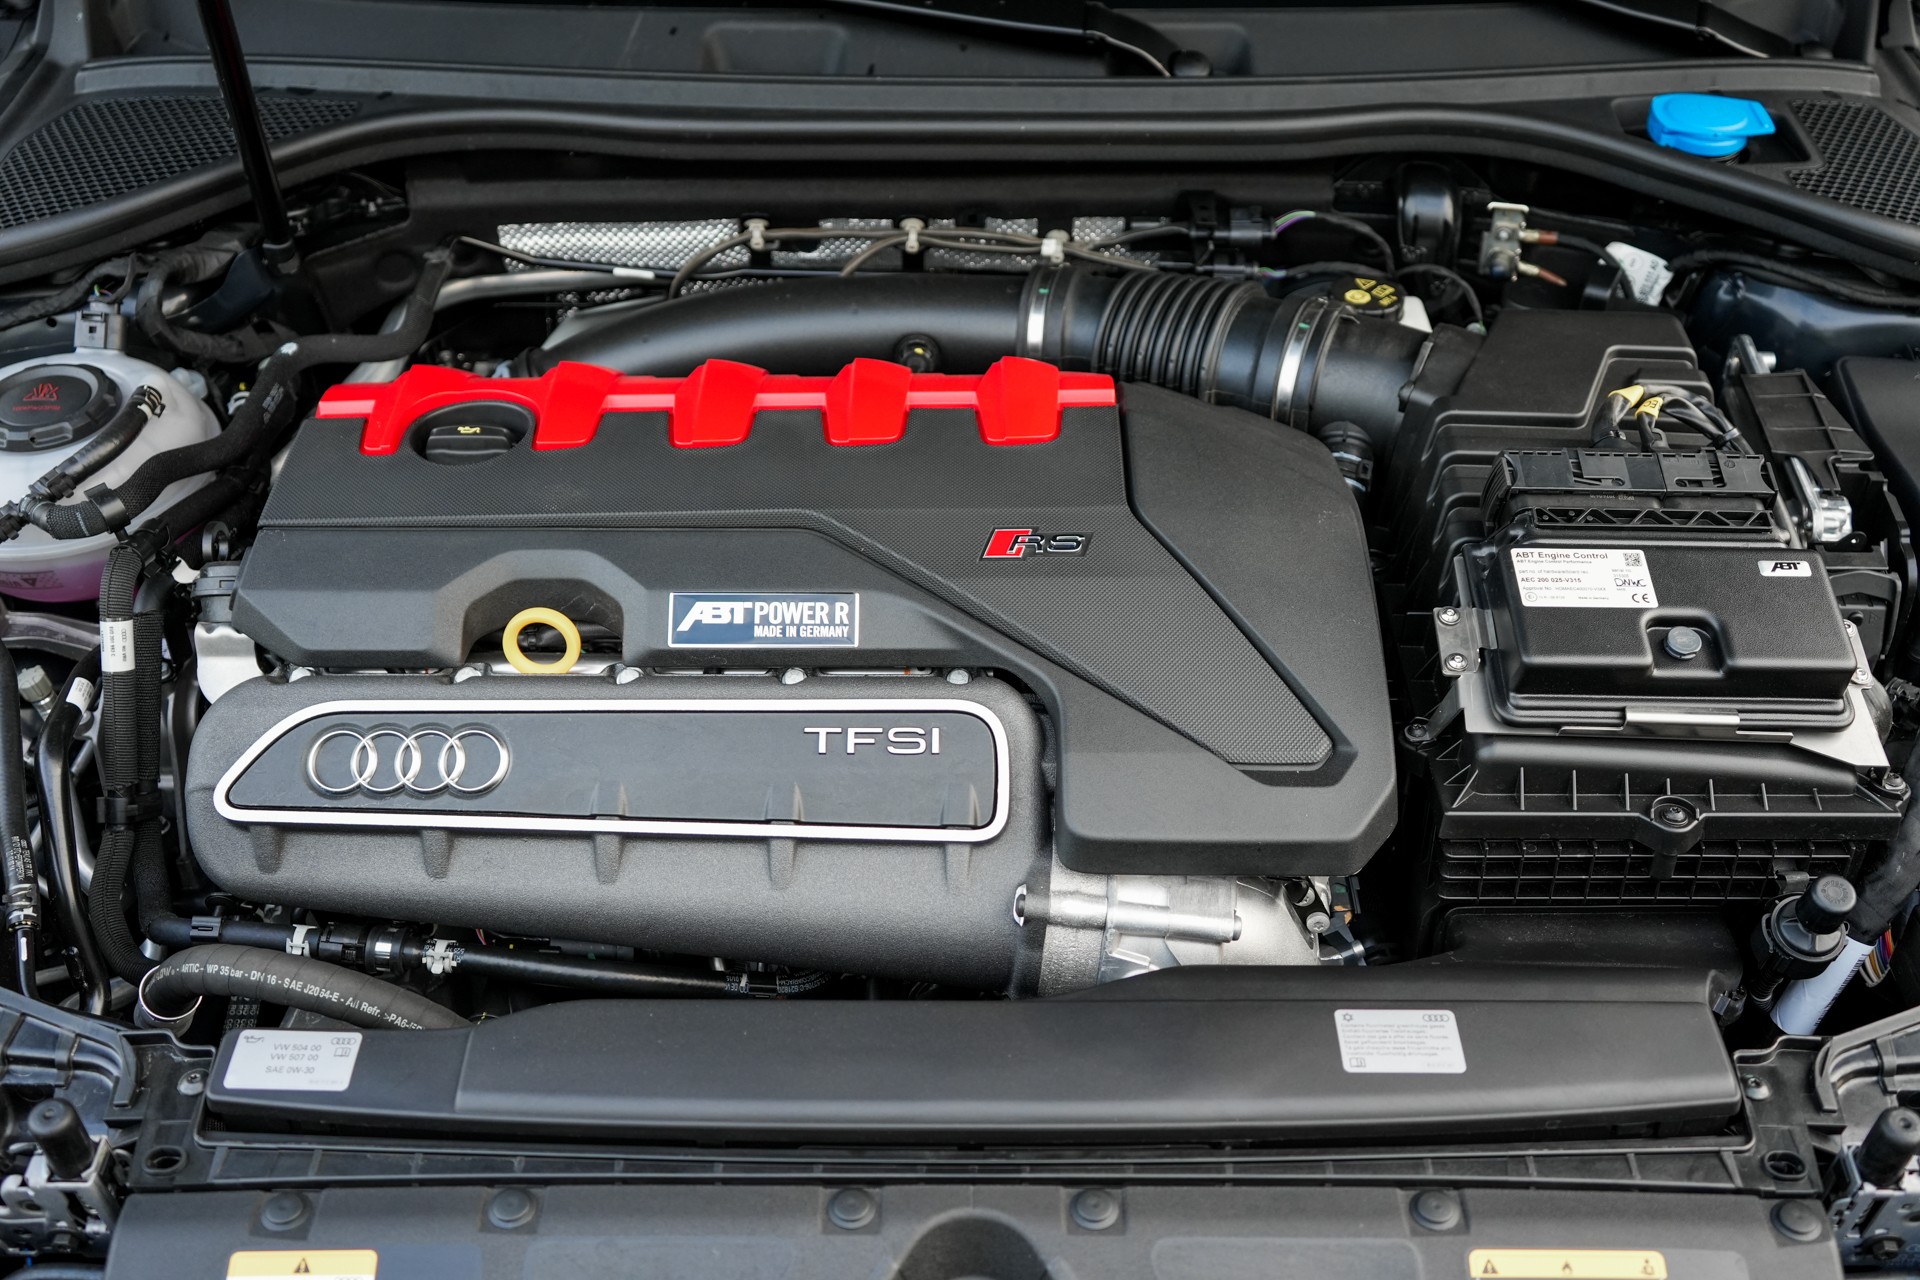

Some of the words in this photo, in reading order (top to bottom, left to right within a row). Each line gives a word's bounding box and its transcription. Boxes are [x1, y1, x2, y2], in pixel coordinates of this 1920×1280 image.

[1000, 531, 1088, 555] RS
[1538, 552, 1570, 561] Engine
[1771, 562, 1801, 573] ABT
[1631, 593, 1650, 603] CE
[677, 601, 752, 631] ABT
[754, 602, 828, 624] POWER
[834, 602, 849, 624] R
[754, 625, 782, 638] MADE
[786, 625, 797, 638] IN
[799, 625, 849, 638] GERMANY
[804, 727, 941, 755] TFSI
[206, 963, 219, 975] WP
[219, 965, 229, 976] 35
[230, 967, 243, 978] bar
[250, 970, 265, 983] DN
[266, 974, 277, 985] 16
[283, 977, 303, 992] SAE
[360, 1001, 381, 1018] Refr.
[273, 1043, 291, 1051] VW
[291, 1043, 308, 1051] 504
[270, 1053, 287, 1061] VW
[288, 1053, 305, 1061] 507
[265, 1065, 283, 1074] SAE
[286, 1065, 315, 1074] 0W-30
